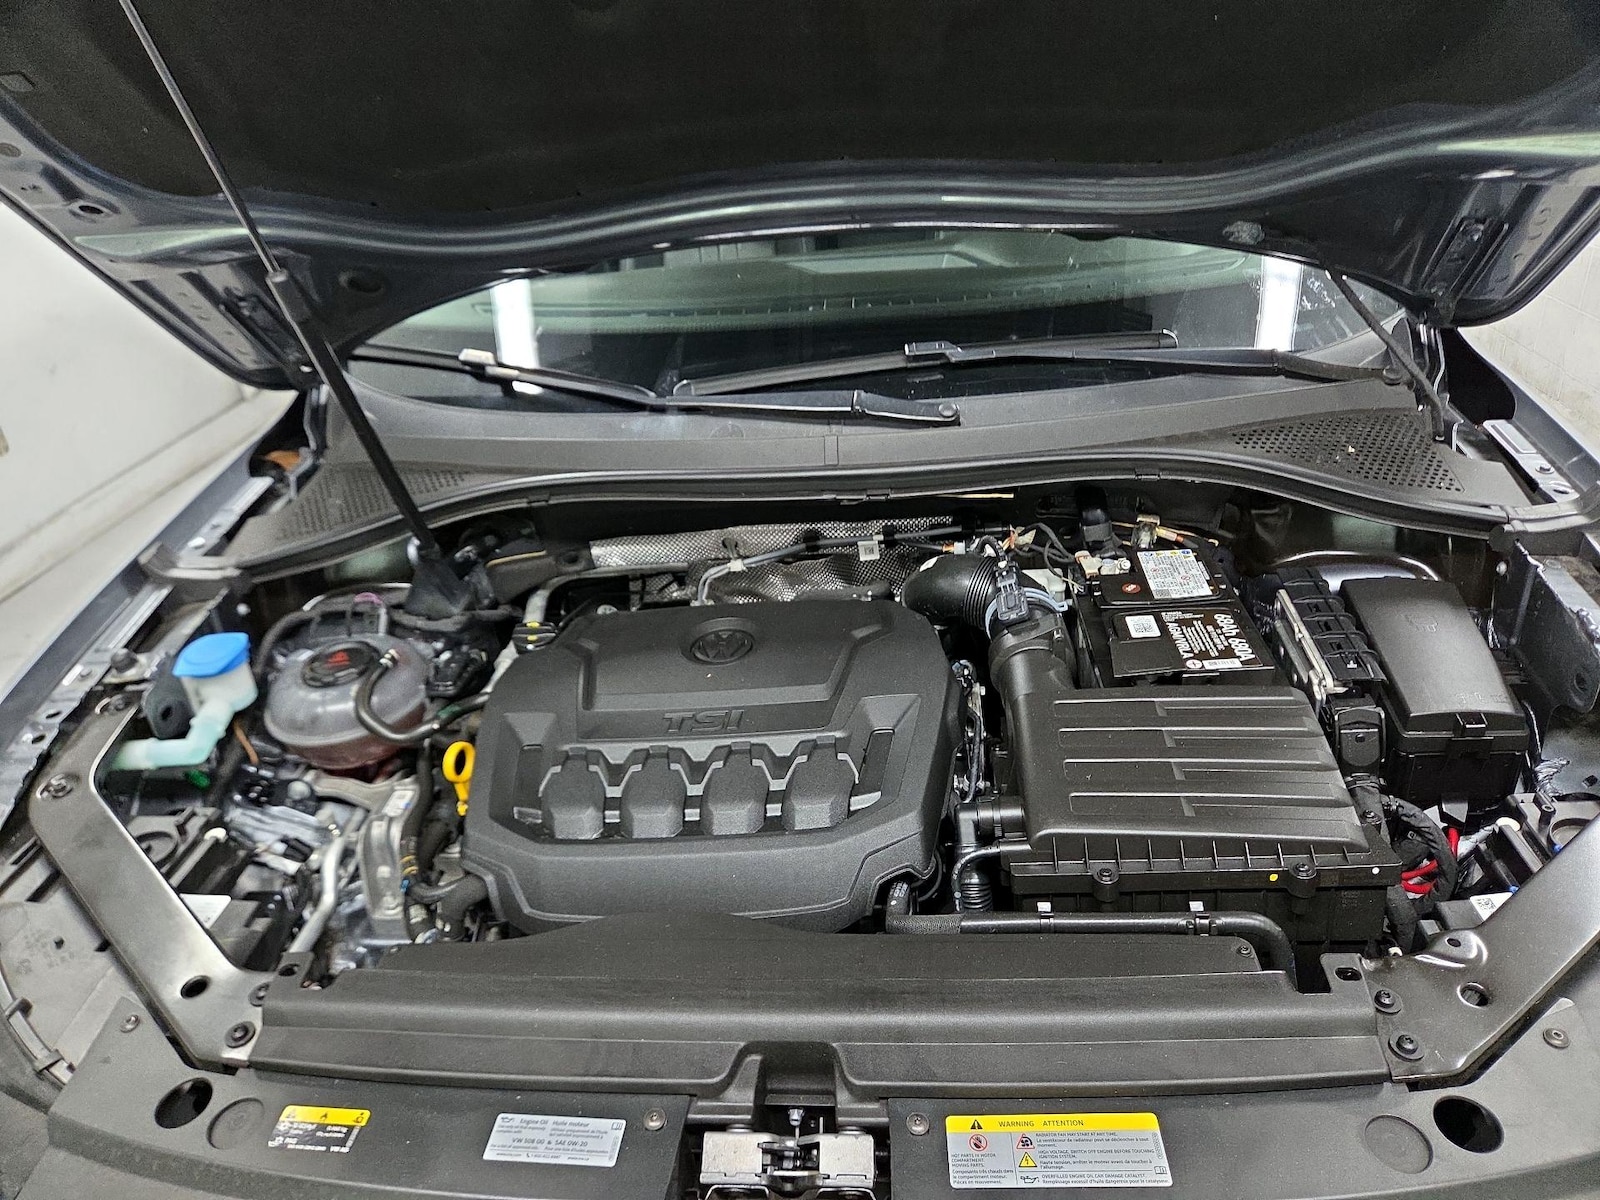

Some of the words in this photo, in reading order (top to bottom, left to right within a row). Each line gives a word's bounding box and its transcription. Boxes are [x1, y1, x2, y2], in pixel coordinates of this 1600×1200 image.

[1214, 613, 1240, 637] 68Ah
[1228, 637, 1256, 661] 680A
[664, 709, 744, 733] TSI
[1042, 1119, 1084, 1127] ATTENTION
